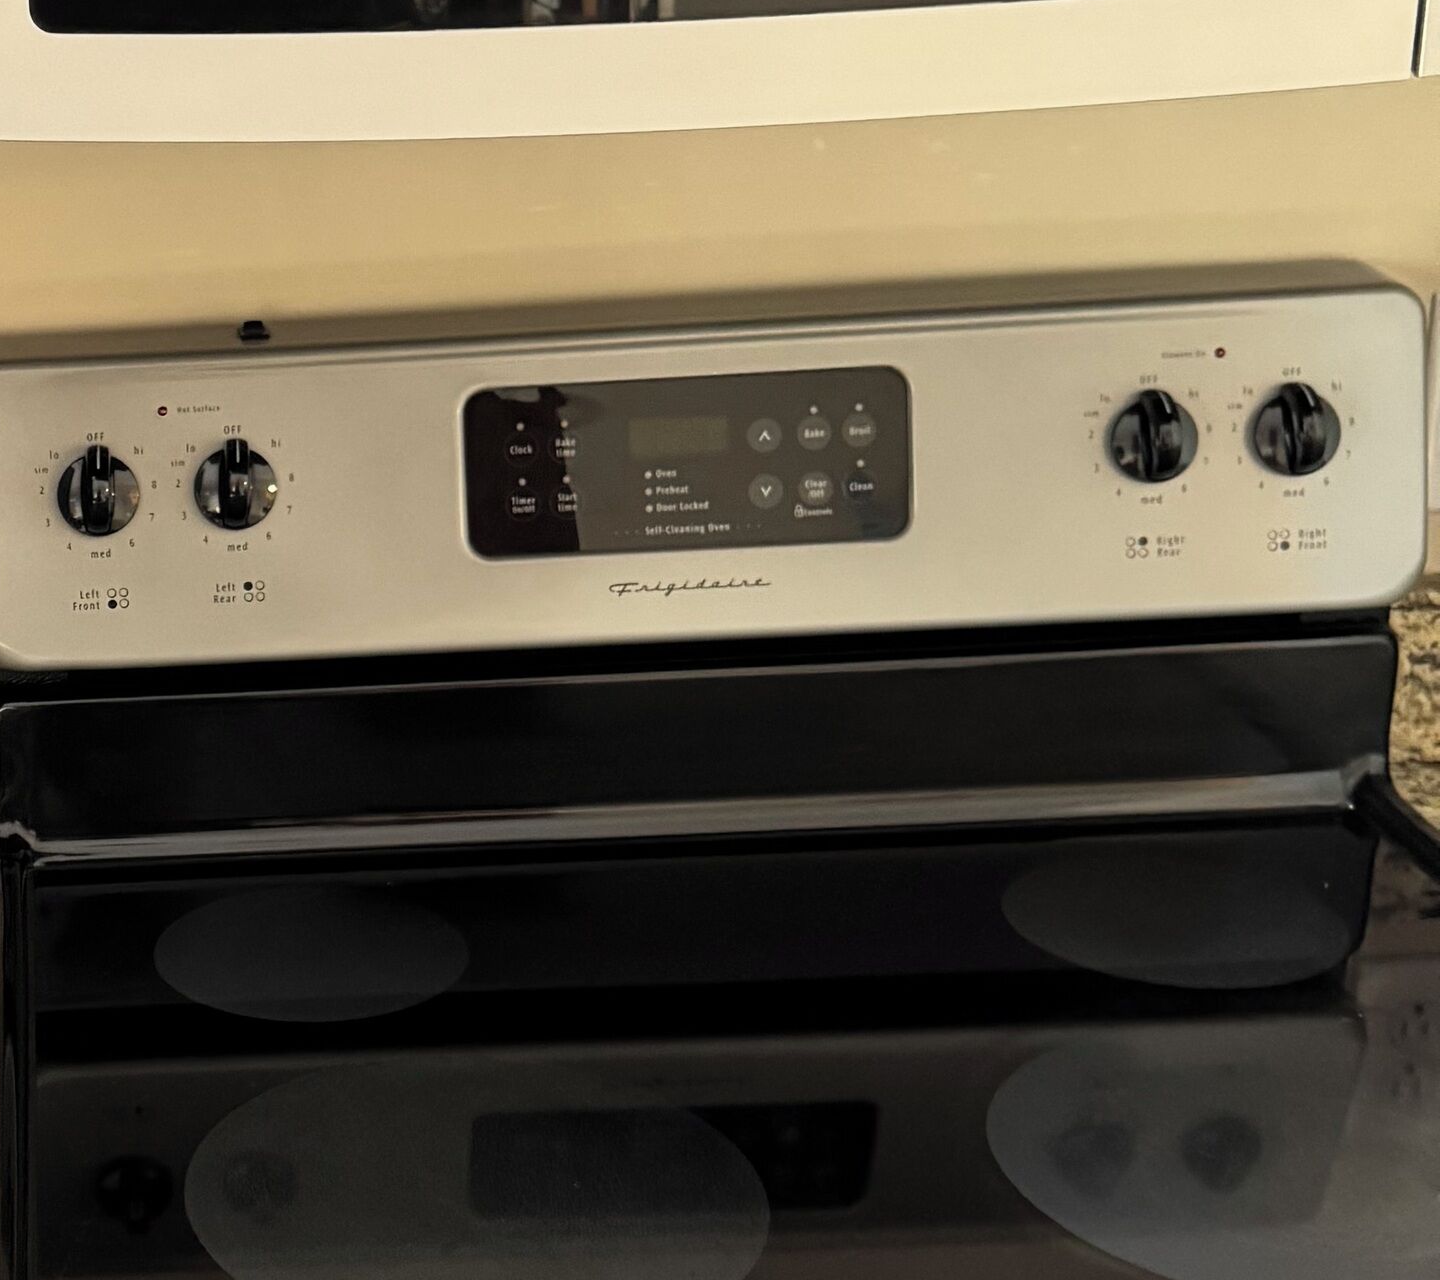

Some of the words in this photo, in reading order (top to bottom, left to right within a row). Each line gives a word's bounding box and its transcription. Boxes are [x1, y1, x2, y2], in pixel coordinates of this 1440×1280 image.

[224, 425, 242, 435] OFF
[86, 432, 104, 441] OFF
[509, 444, 533, 455] Clock
[655, 470, 677, 479] Oven
[176, 479, 181, 488] 2
[849, 482, 874, 492] Clean
[40, 486, 45, 495] 2
[655, 485, 689, 495] Preheat
[287, 505, 293, 514] 7
[679, 501, 709, 511] Locked
[266, 532, 271, 540] 6
[66, 542, 72, 550] 4
[129, 539, 135, 547] 6
[227, 542, 248, 551] med
[90, 549, 111, 558] med
[215, 582, 235, 592] Left
[609, 578, 771, 597] Frigidaire
[80, 589, 100, 599] Left
[213, 594, 236, 604] Rear
[72, 602, 100, 611] Front
